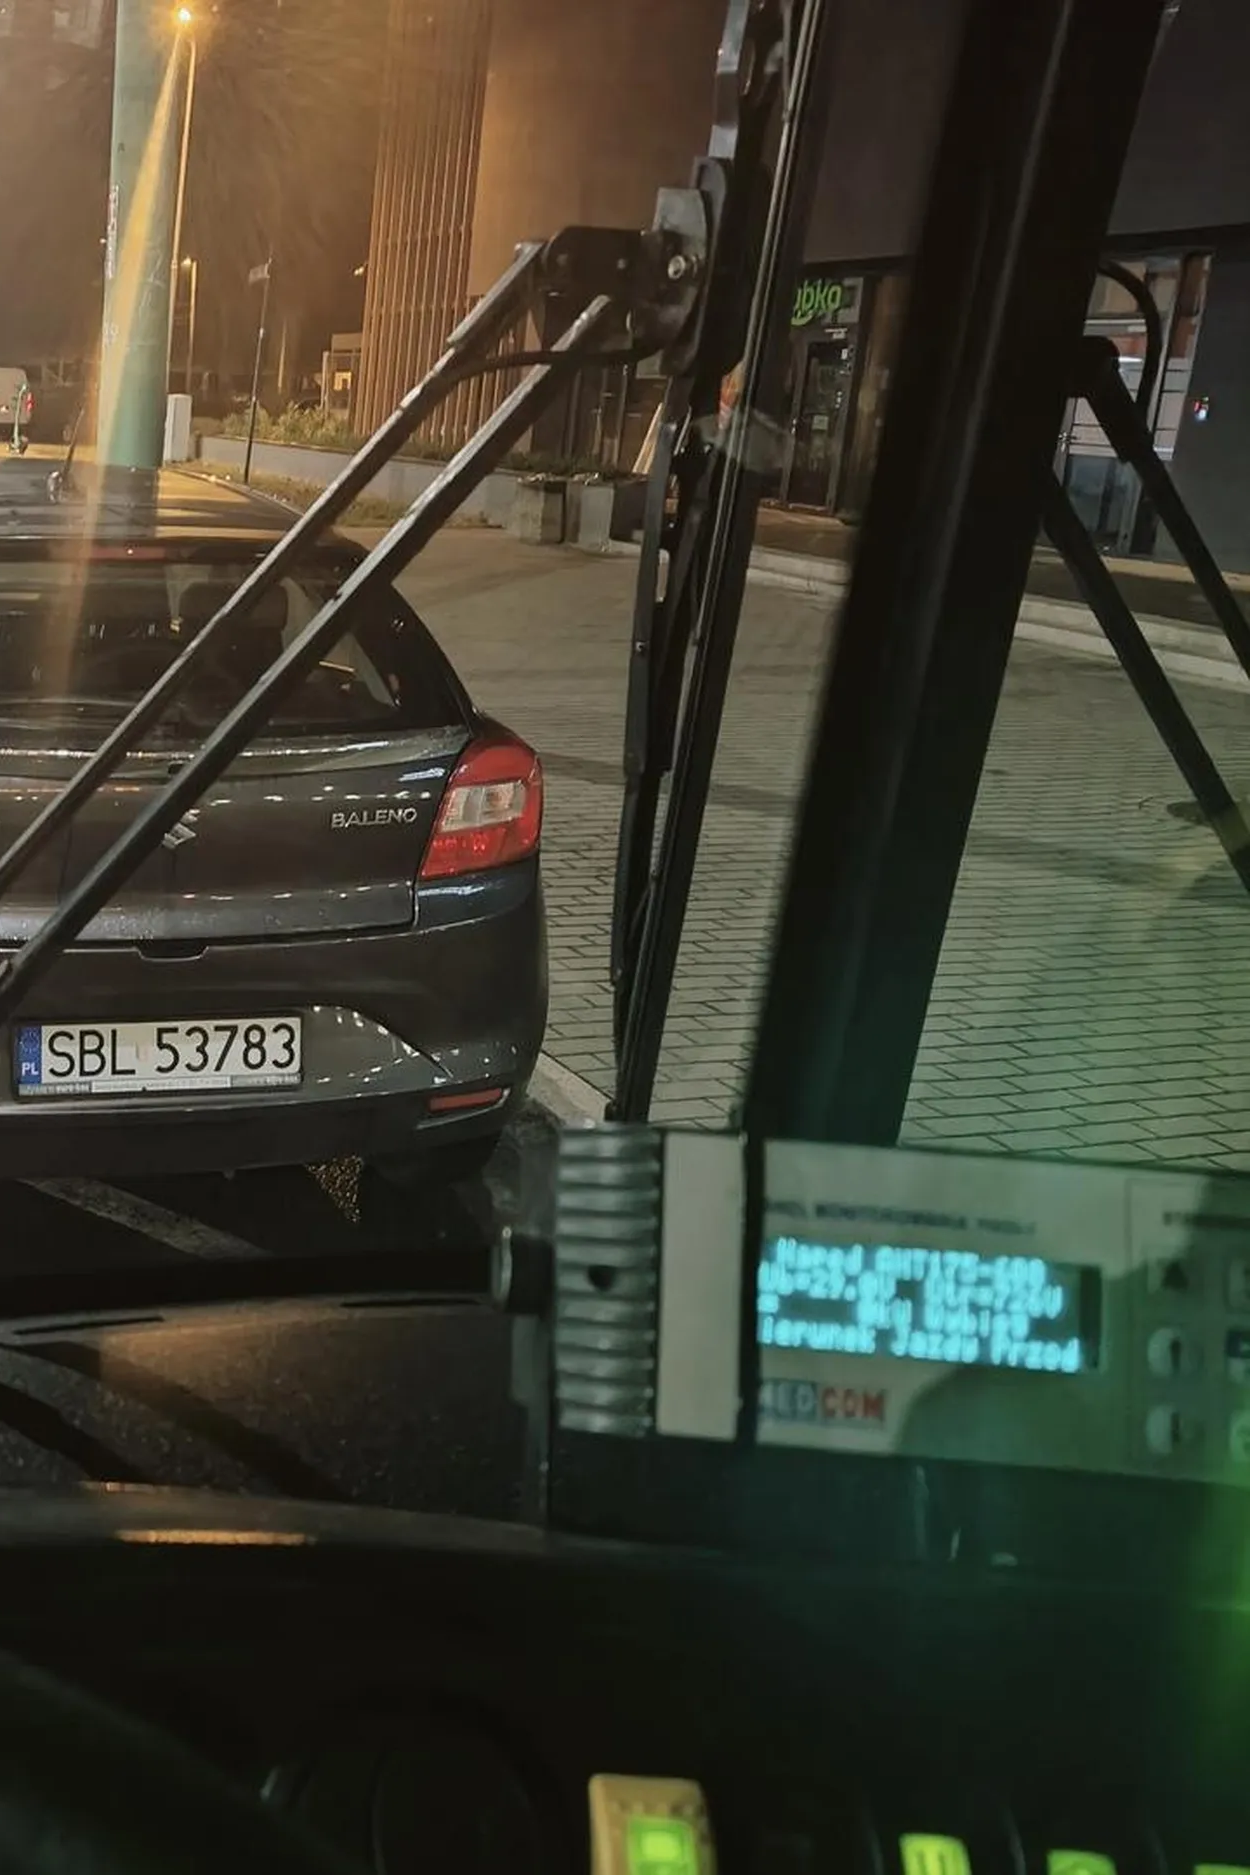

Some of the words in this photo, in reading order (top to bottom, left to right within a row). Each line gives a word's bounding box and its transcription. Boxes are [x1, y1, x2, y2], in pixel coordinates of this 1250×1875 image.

[331, 807, 418, 829] BALENO
[47, 1028, 137, 1078] SBL
[155, 1022, 297, 1074] 53783
[21, 1061, 40, 1076] PL
